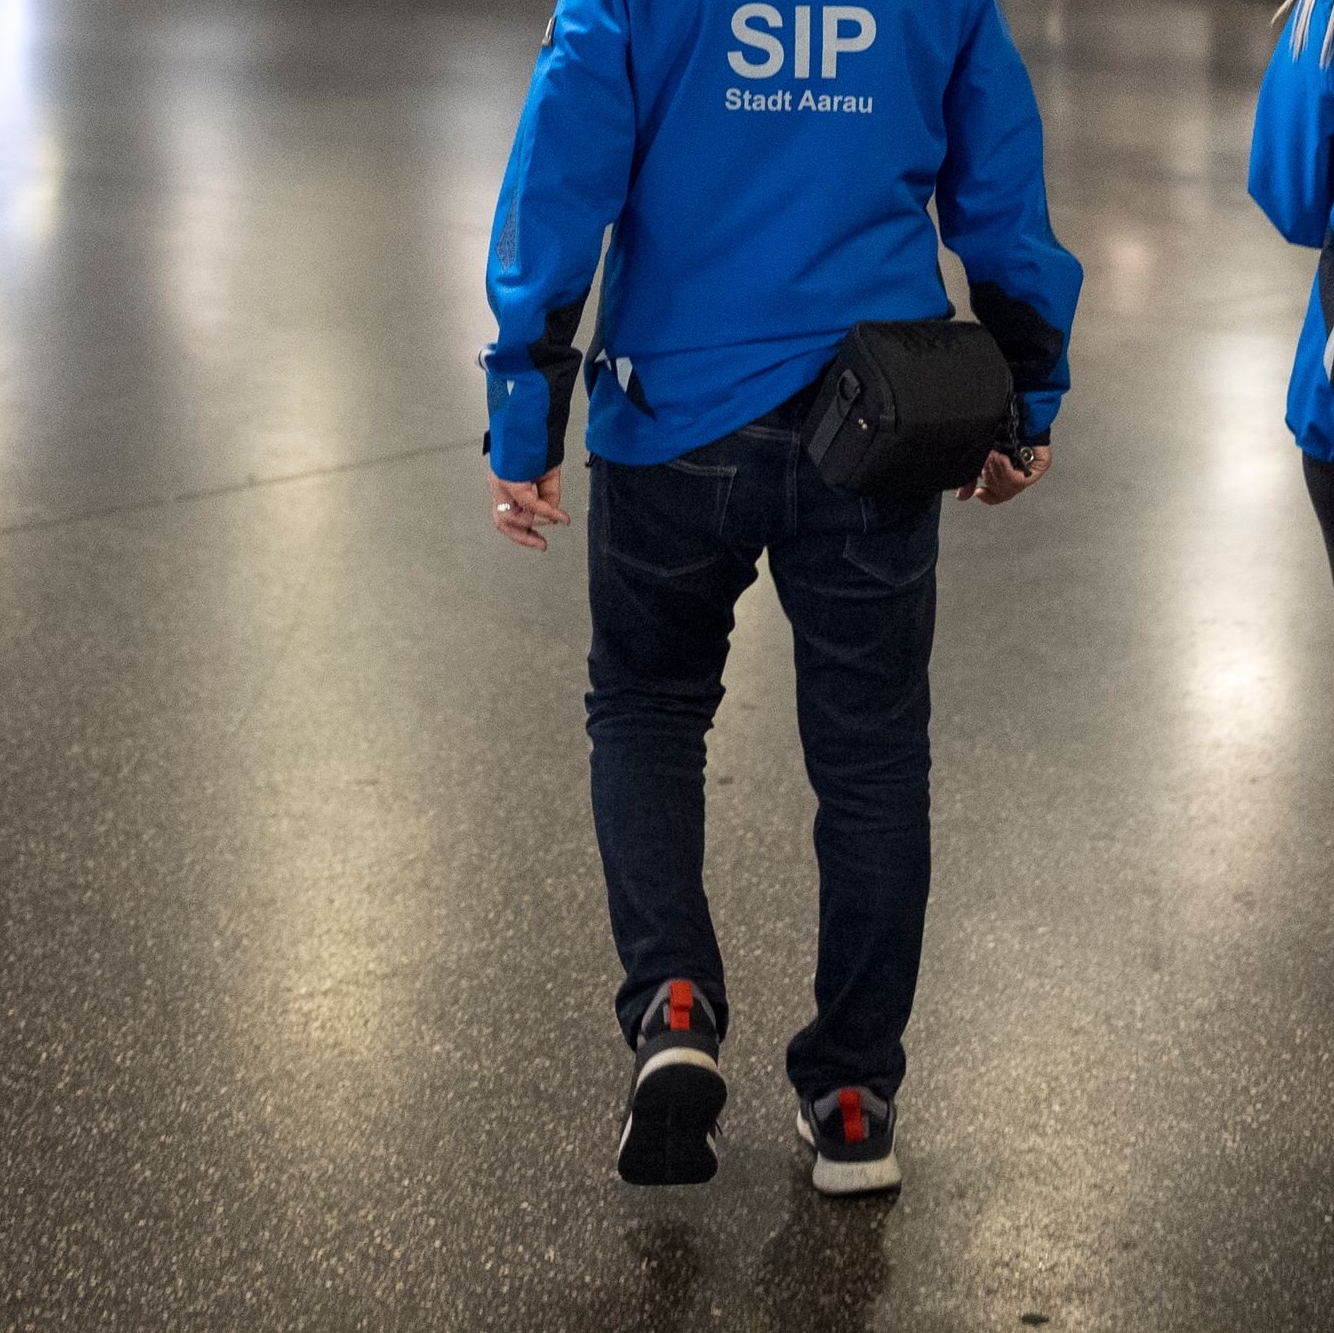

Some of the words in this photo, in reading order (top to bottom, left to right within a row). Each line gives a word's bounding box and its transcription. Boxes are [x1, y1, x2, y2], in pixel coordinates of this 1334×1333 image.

[726, 3, 877, 80] SIP
[724, 88, 792, 113] Stadt
[799, 90, 874, 115] Aarau
